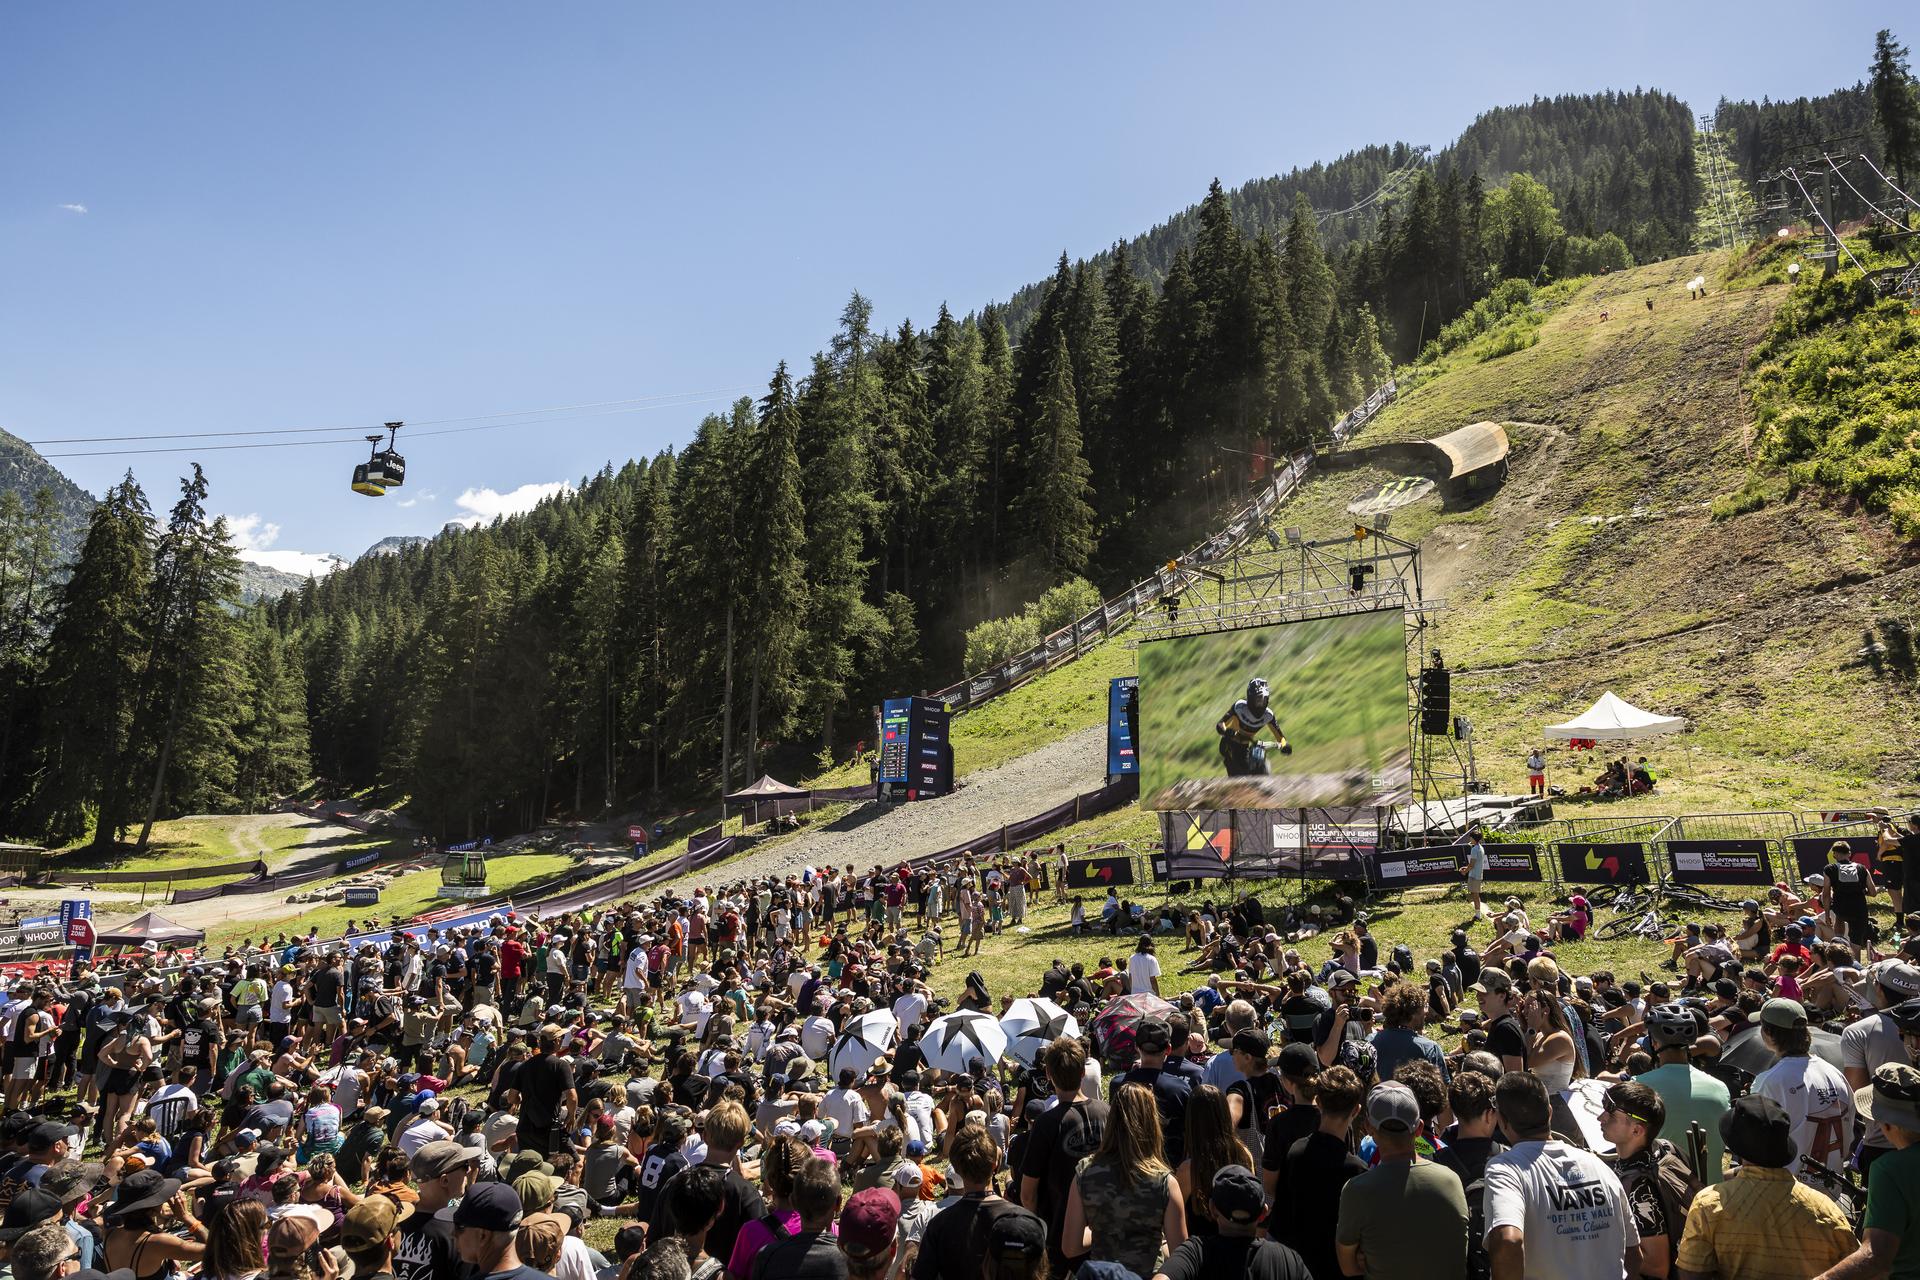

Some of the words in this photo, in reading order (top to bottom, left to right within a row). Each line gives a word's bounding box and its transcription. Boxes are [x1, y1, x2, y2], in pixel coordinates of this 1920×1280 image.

[386, 460, 405, 473] Jeep
[345, 852, 379, 868] SHIMANO
[25, 931, 59, 942] WHOOP
[642, 1154, 666, 1190] 8
[1545, 1186, 1606, 1211] VANS
[1571, 1212, 1588, 1221] THE
